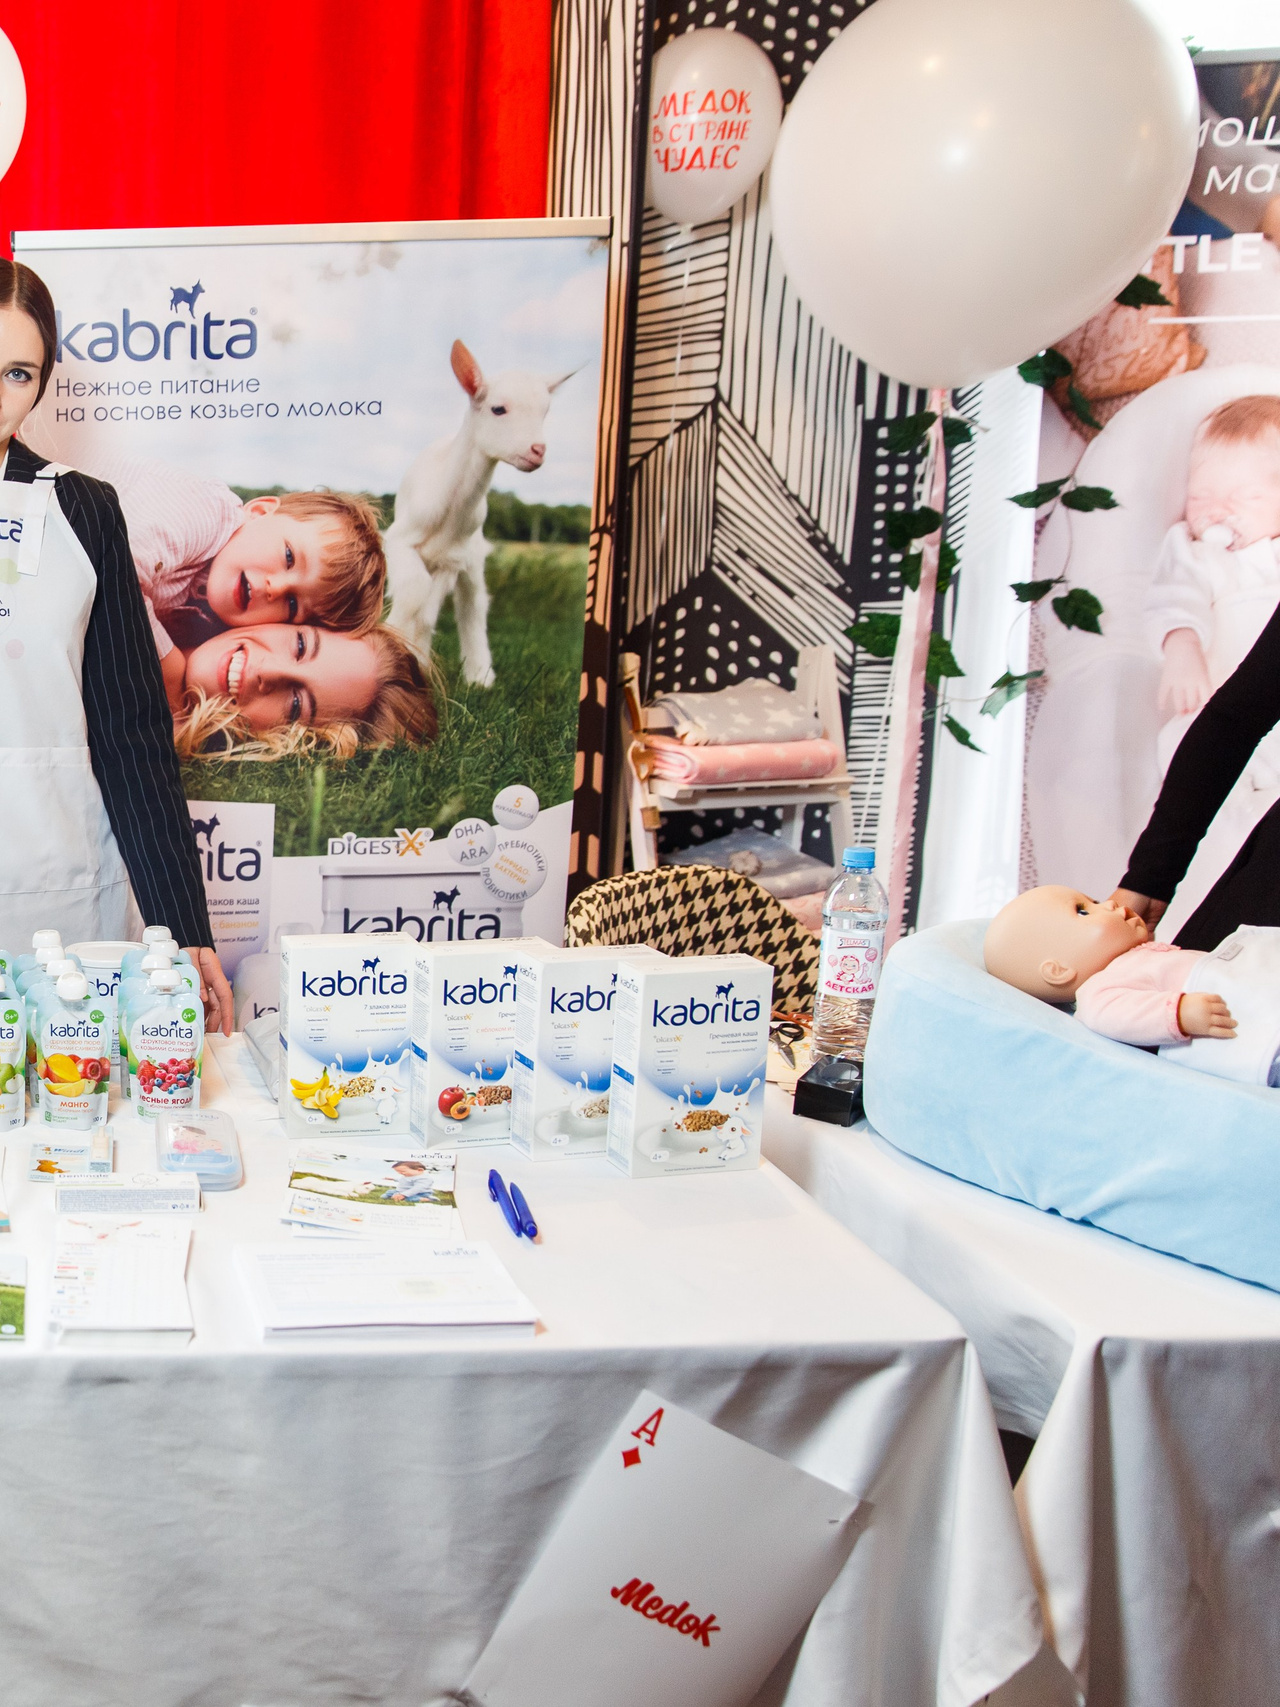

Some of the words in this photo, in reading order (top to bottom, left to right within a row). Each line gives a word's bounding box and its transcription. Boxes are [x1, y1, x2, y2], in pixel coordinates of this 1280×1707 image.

[653, 88, 752, 120] МЕДОК
[669, 120, 752, 143] СТРАНЕ
[654, 144, 740, 173] ЧУДЕС
[56, 308, 258, 363] kabrita
[56, 378, 152, 397] Нежное
[161, 378, 260, 394] питание
[56, 405, 85, 422] на
[94, 402, 182, 420] основе
[190, 400, 280, 420] козьего
[287, 399, 383, 418] молока
[513, 797, 524, 809] 5
[455, 823, 485, 839] DHA
[460, 846, 489, 862] ARA
[498, 840, 546, 873] ПРЕБИОТИКИ
[482, 867, 529, 901] ПРОБИОТИКИ
[494, 862, 528, 886] БАКТЕРИИ
[237, 898, 260, 906] каша
[220, 920, 259, 930] бананом
[343, 907, 501, 942] kabrita
[302, 970, 407, 998] kabrita
[825, 980, 875, 995] ДЕТСКАЯ
[652, 997, 760, 1028] kabrita
[50, 1023, 100, 1038] kabrita
[141, 1024, 194, 1039] kabrita
[709, 1032, 741, 1040] Гречневая
[140, 1038, 176, 1047] фруктовое
[60, 1101, 89, 1109] манго
[433, 1248, 480, 1257] kabrita
[631, 1407, 664, 1447] A
[610, 1577, 721, 1648] Medok
